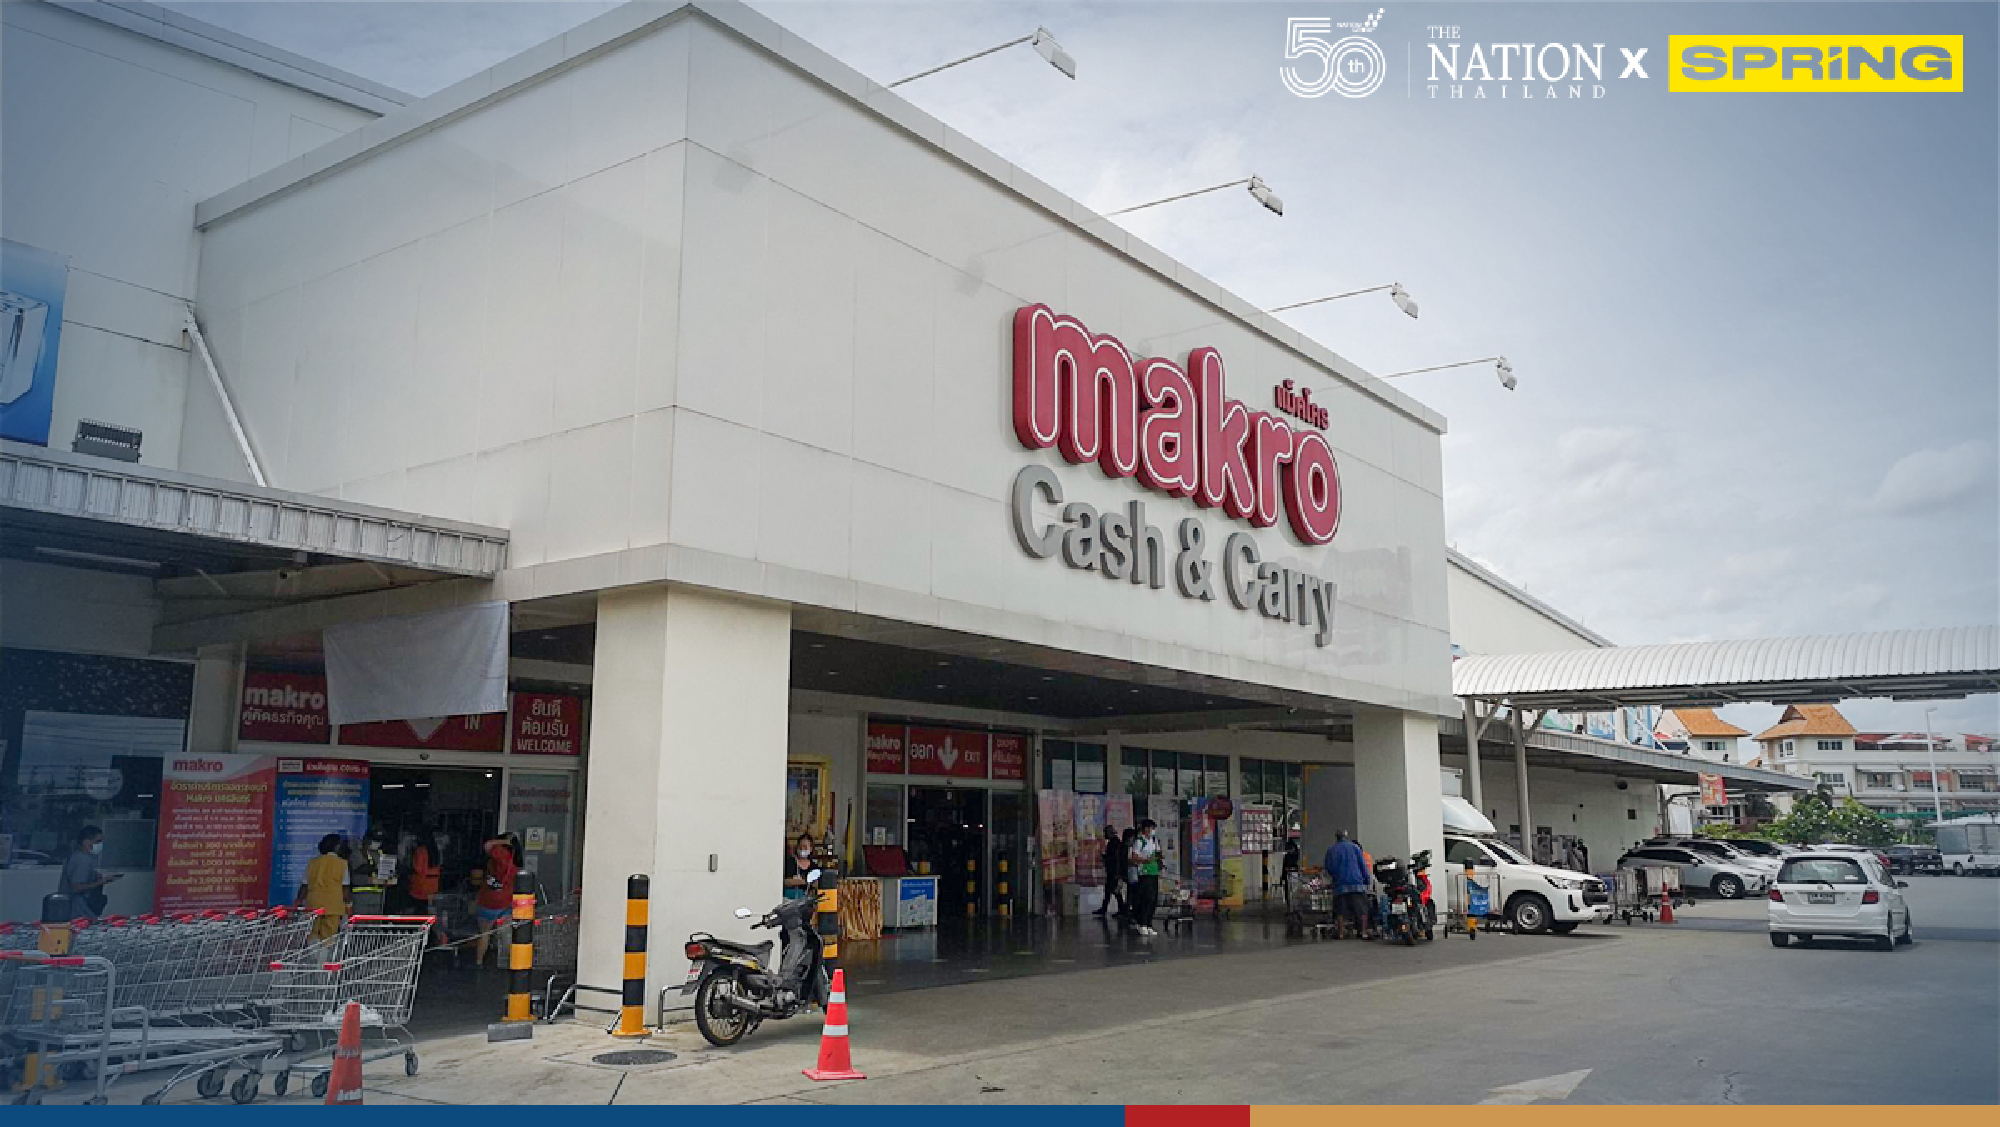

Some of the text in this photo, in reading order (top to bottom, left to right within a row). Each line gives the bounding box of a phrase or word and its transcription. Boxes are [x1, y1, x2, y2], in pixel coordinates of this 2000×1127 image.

[1013, 303, 1342, 545] makro
[1012, 464, 1337, 647] Cash & Carry
[244, 685, 325, 710] makro
[532, 698, 563, 717] ยินดี
[465, 715, 480, 730] IN
[521, 715, 569, 737] ต้อนรับ
[517, 738, 573, 752] WELCOME
[172, 758, 223, 772] makro
[964, 750, 981, 763] EXIT
